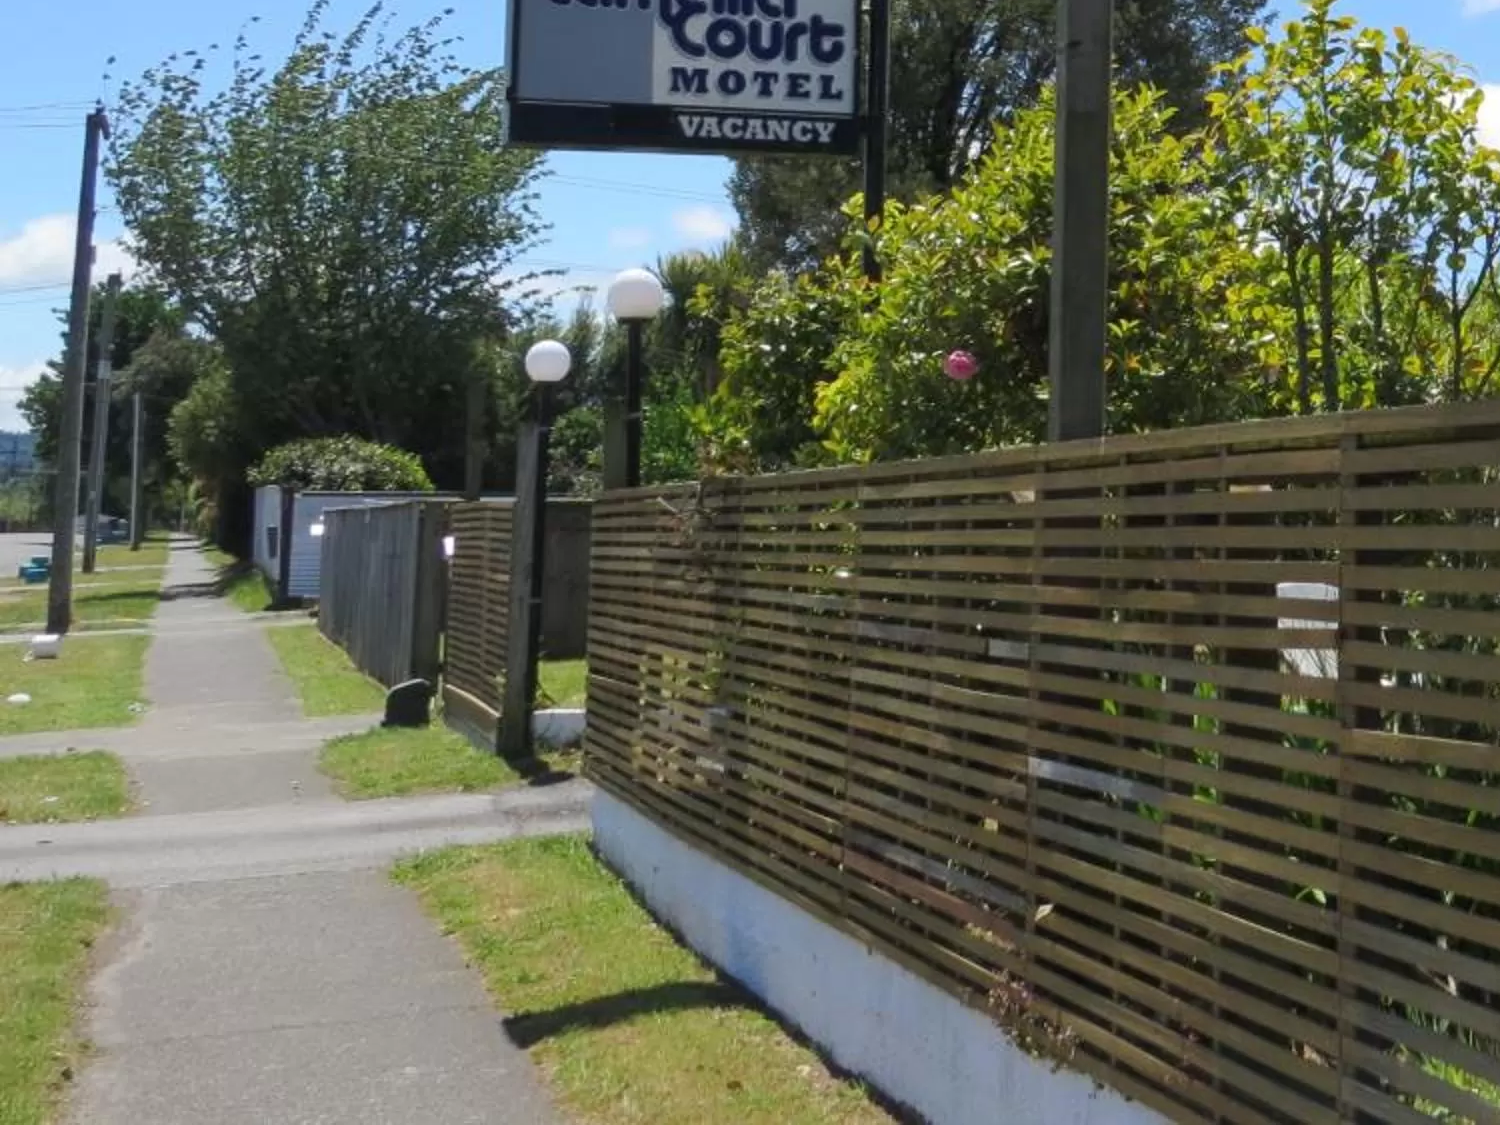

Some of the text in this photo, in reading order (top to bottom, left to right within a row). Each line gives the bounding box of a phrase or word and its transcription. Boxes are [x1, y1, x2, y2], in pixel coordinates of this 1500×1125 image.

[671, 8, 846, 64] Court
[670, 67, 843, 100] MOTEL
[677, 114, 837, 143] VACANCY
